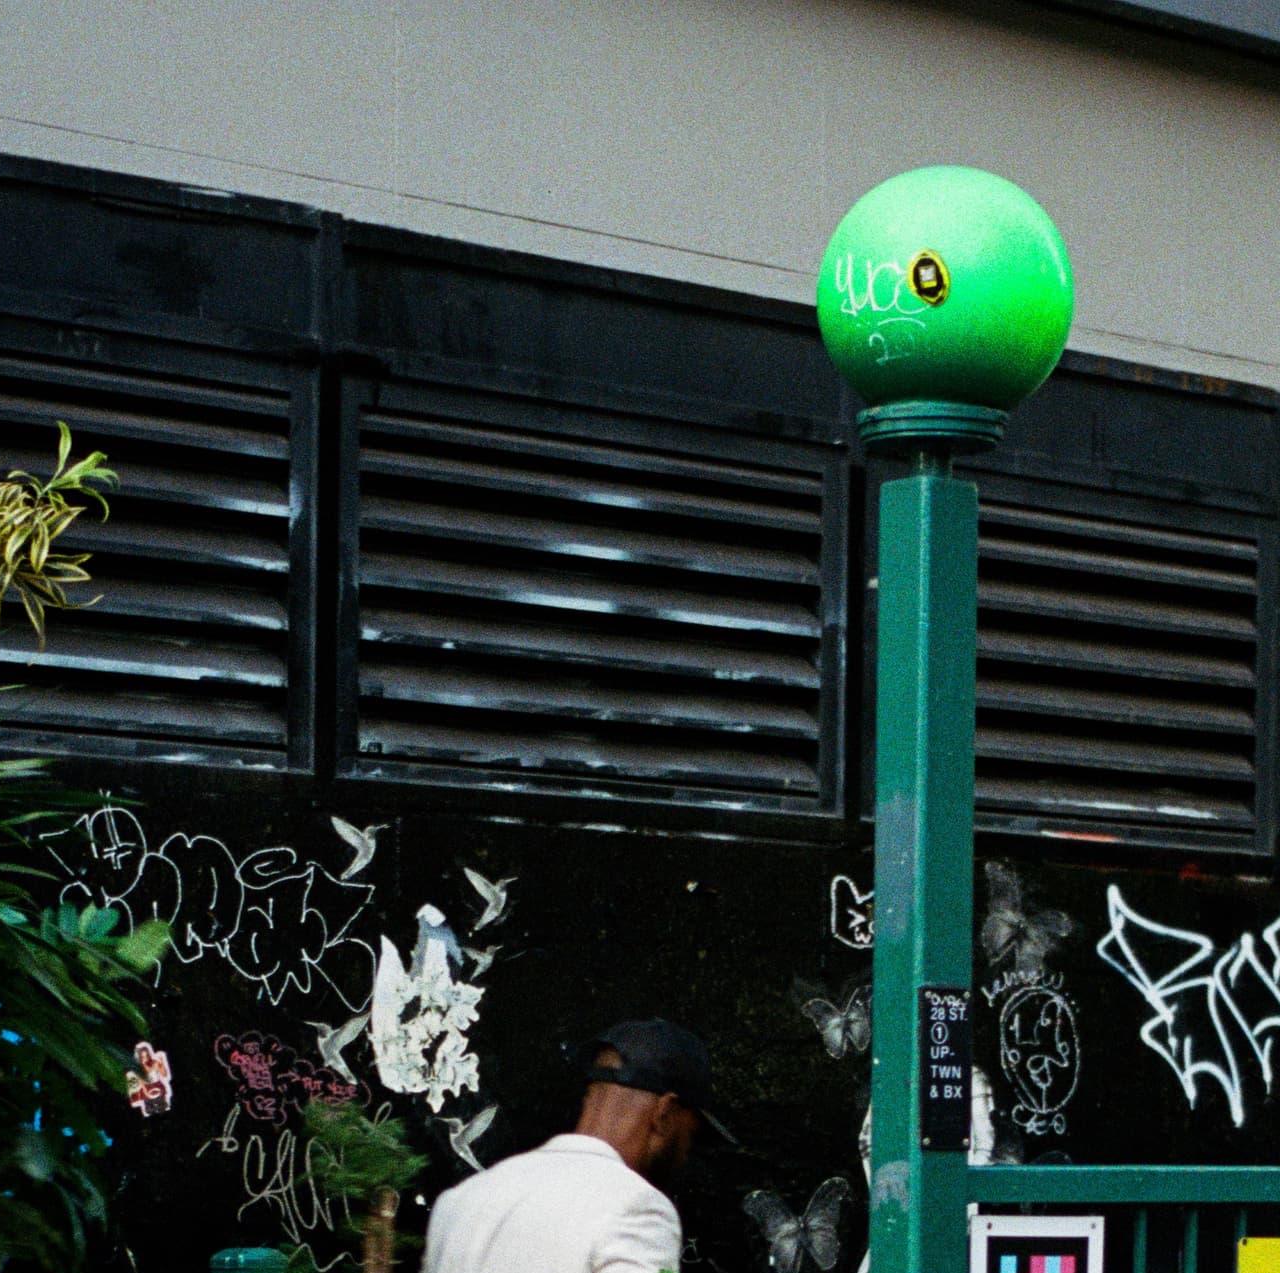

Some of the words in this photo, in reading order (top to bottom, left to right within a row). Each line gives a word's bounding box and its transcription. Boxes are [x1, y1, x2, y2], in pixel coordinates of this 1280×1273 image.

[930, 1007, 946, 1021] 28
[930, 1046, 956, 1059] UP-
[930, 1065, 962, 1079] TWN
[930, 1084, 939, 1099] &
[943, 1085, 963, 1099] BX
